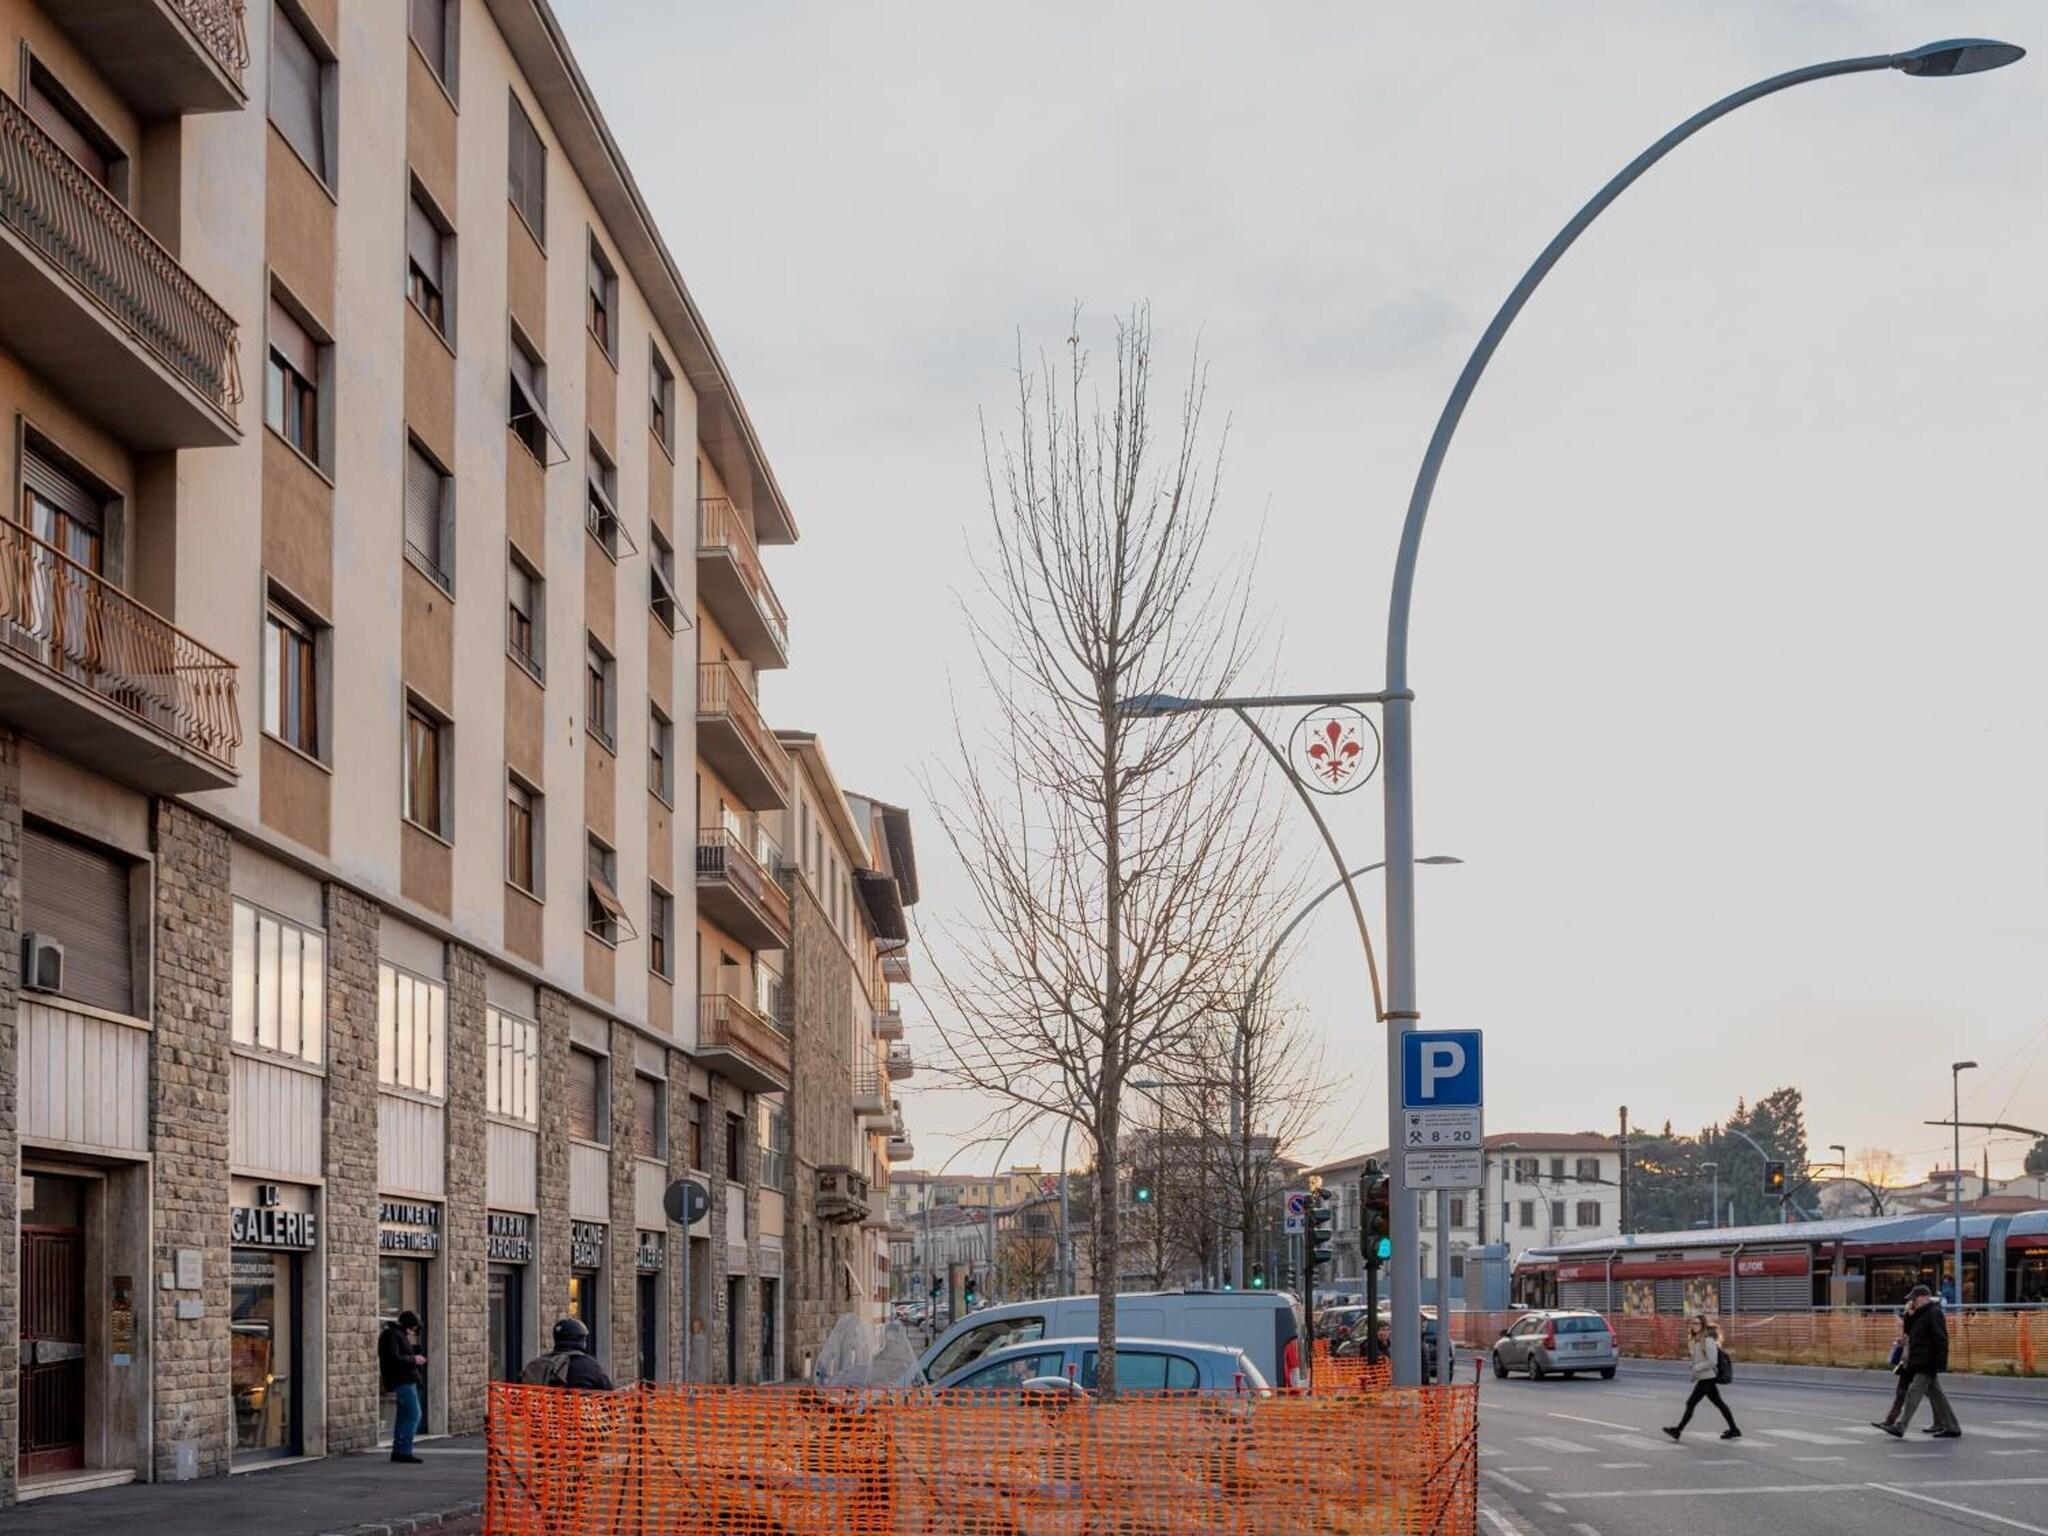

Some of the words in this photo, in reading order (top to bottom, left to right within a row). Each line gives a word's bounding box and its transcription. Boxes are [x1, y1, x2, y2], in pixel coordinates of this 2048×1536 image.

[1421, 1041, 1465, 1098] P
[1431, 1130, 1440, 1142] 8
[1454, 1131, 1472, 1141] 20
[266, 1184, 281, 1206] LA
[379, 1203, 440, 1225] PAVIMENTI
[231, 1208, 315, 1246] GALERIE
[492, 1215, 527, 1237] MARMI
[571, 1222, 603, 1244] CUCINE
[379, 1230, 440, 1250] RIVESTIMENTI
[486, 1237, 532, 1260] PARQUETS
[574, 1244, 600, 1267] BAGNI
